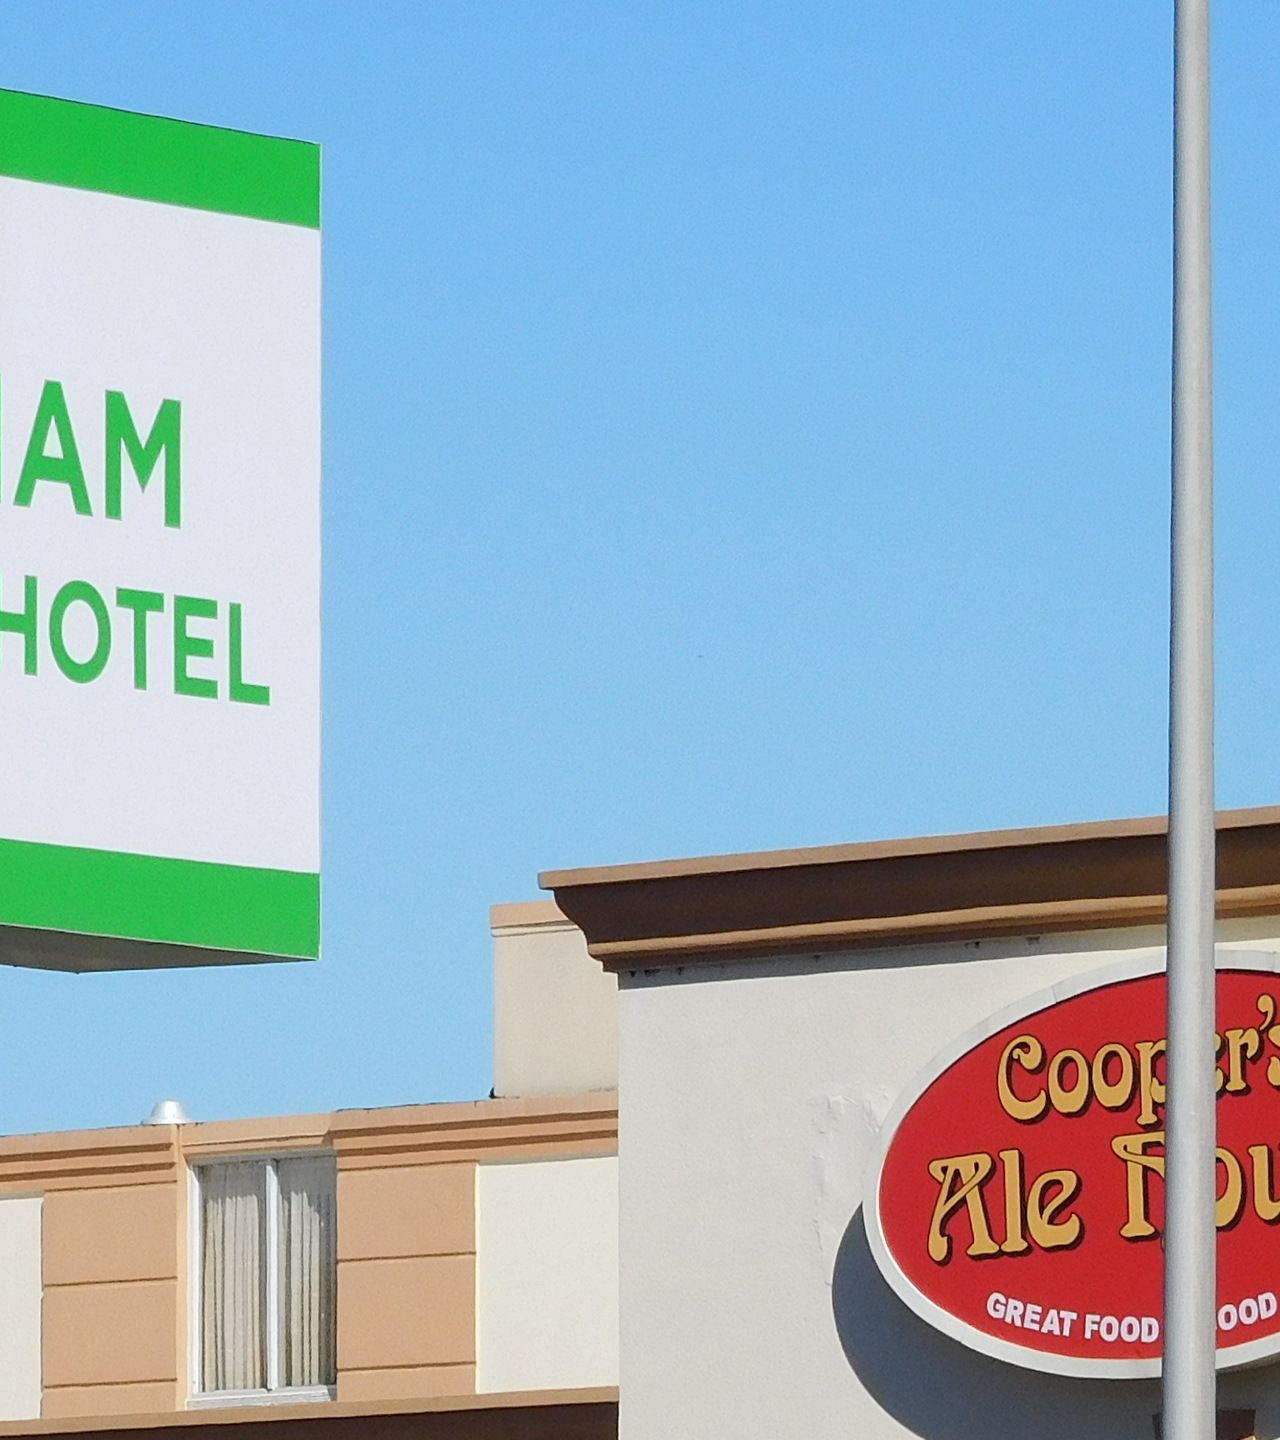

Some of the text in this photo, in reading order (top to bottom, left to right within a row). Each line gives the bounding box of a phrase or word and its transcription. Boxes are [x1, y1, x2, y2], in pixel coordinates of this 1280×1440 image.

[927, 1149, 1082, 1263] Ale
[986, 1291, 1078, 1337] GREAT
[1083, 1313, 1160, 1344] FOOD
[1216, 1291, 1278, 1332] OOD
